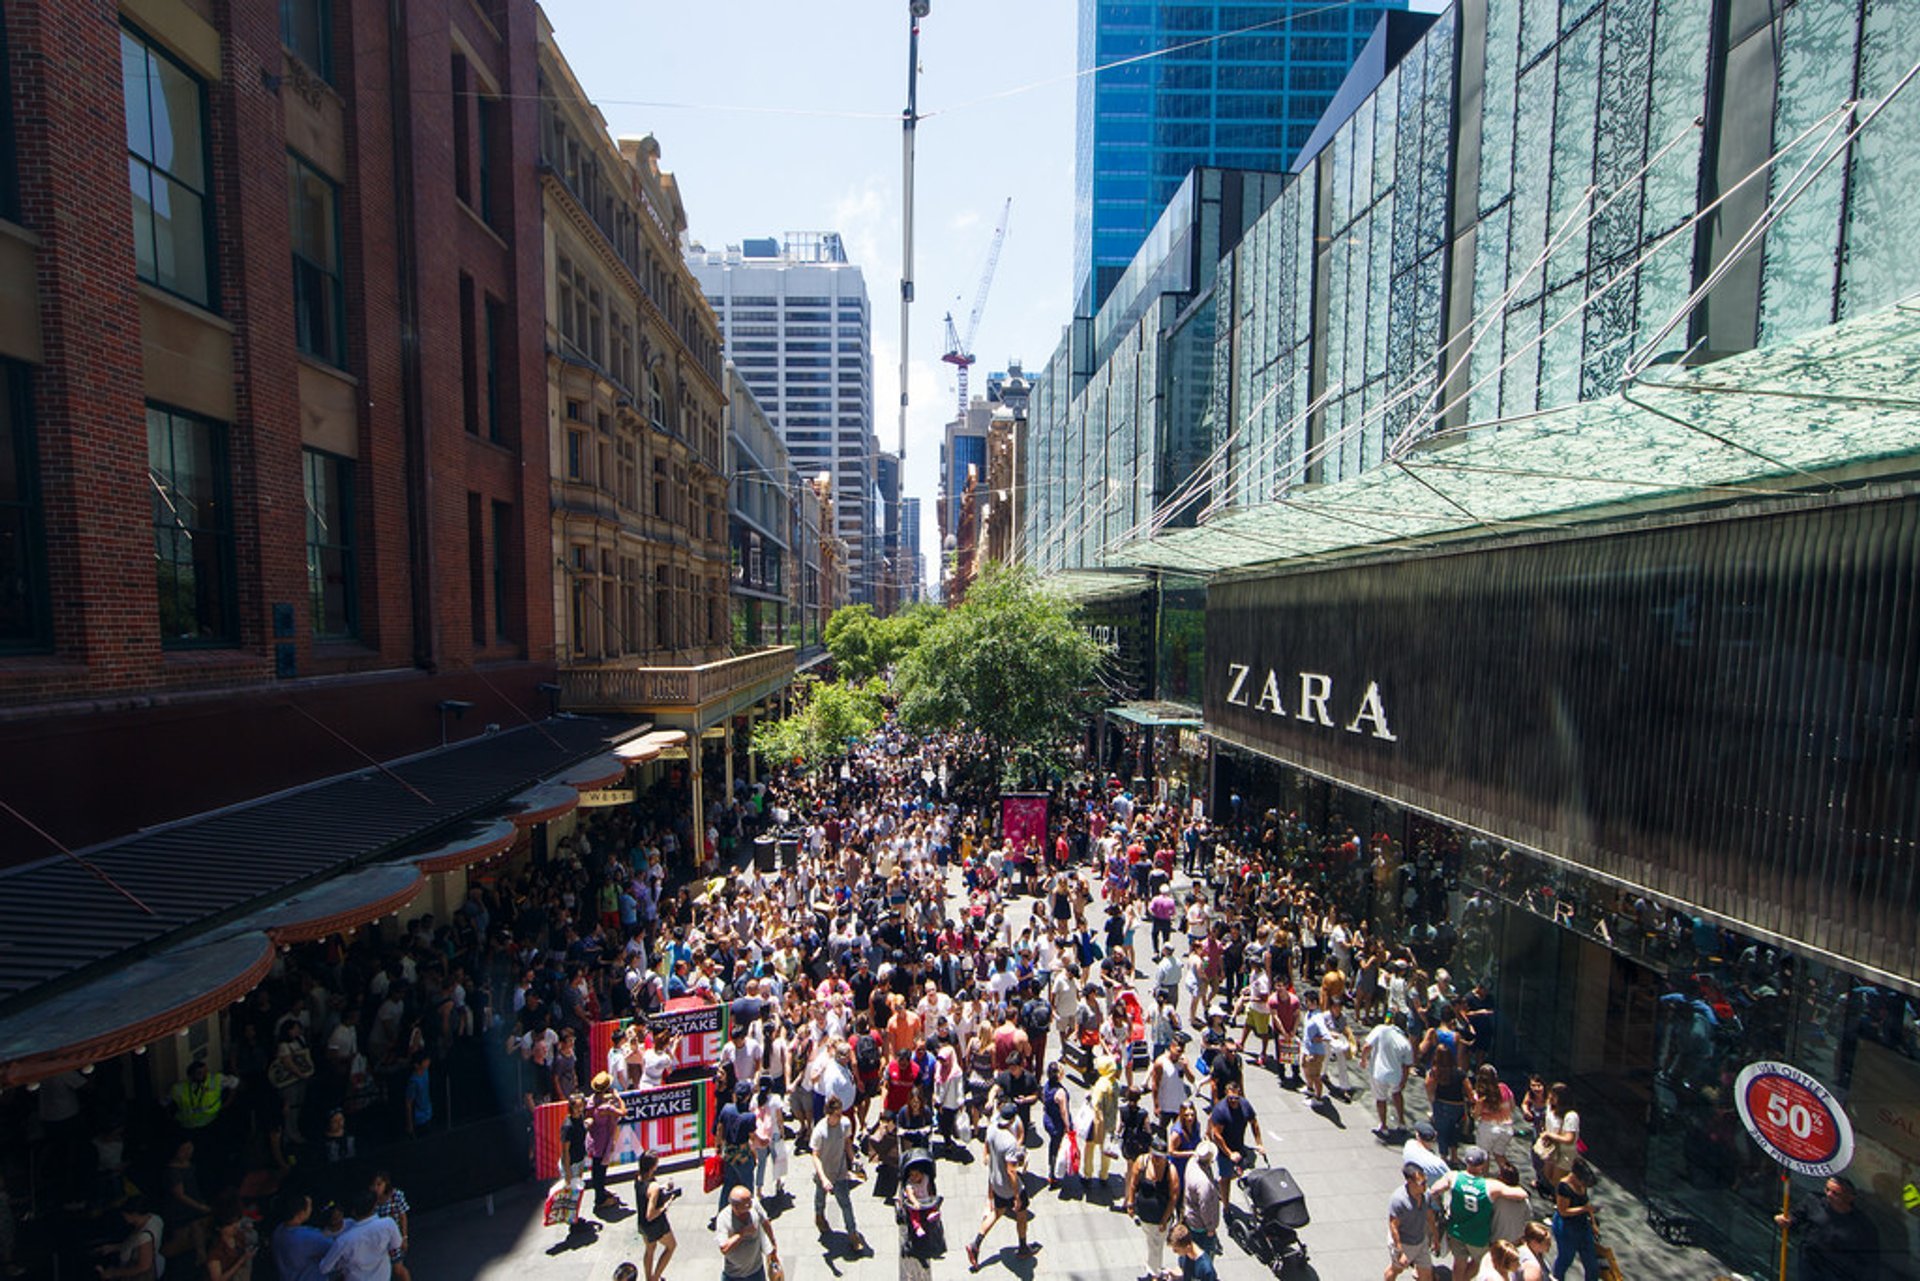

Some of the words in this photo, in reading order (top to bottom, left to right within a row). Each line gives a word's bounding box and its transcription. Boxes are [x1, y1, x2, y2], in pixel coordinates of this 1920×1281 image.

[1226, 663, 1397, 742] ZARA
[590, 792, 627, 801] WEST
[671, 1018, 718, 1034] KTAKE
[1781, 1066, 1831, 1099] OUTLET
[651, 1088, 692, 1102] BIGGEST
[1766, 1093, 1824, 1139] 50%
